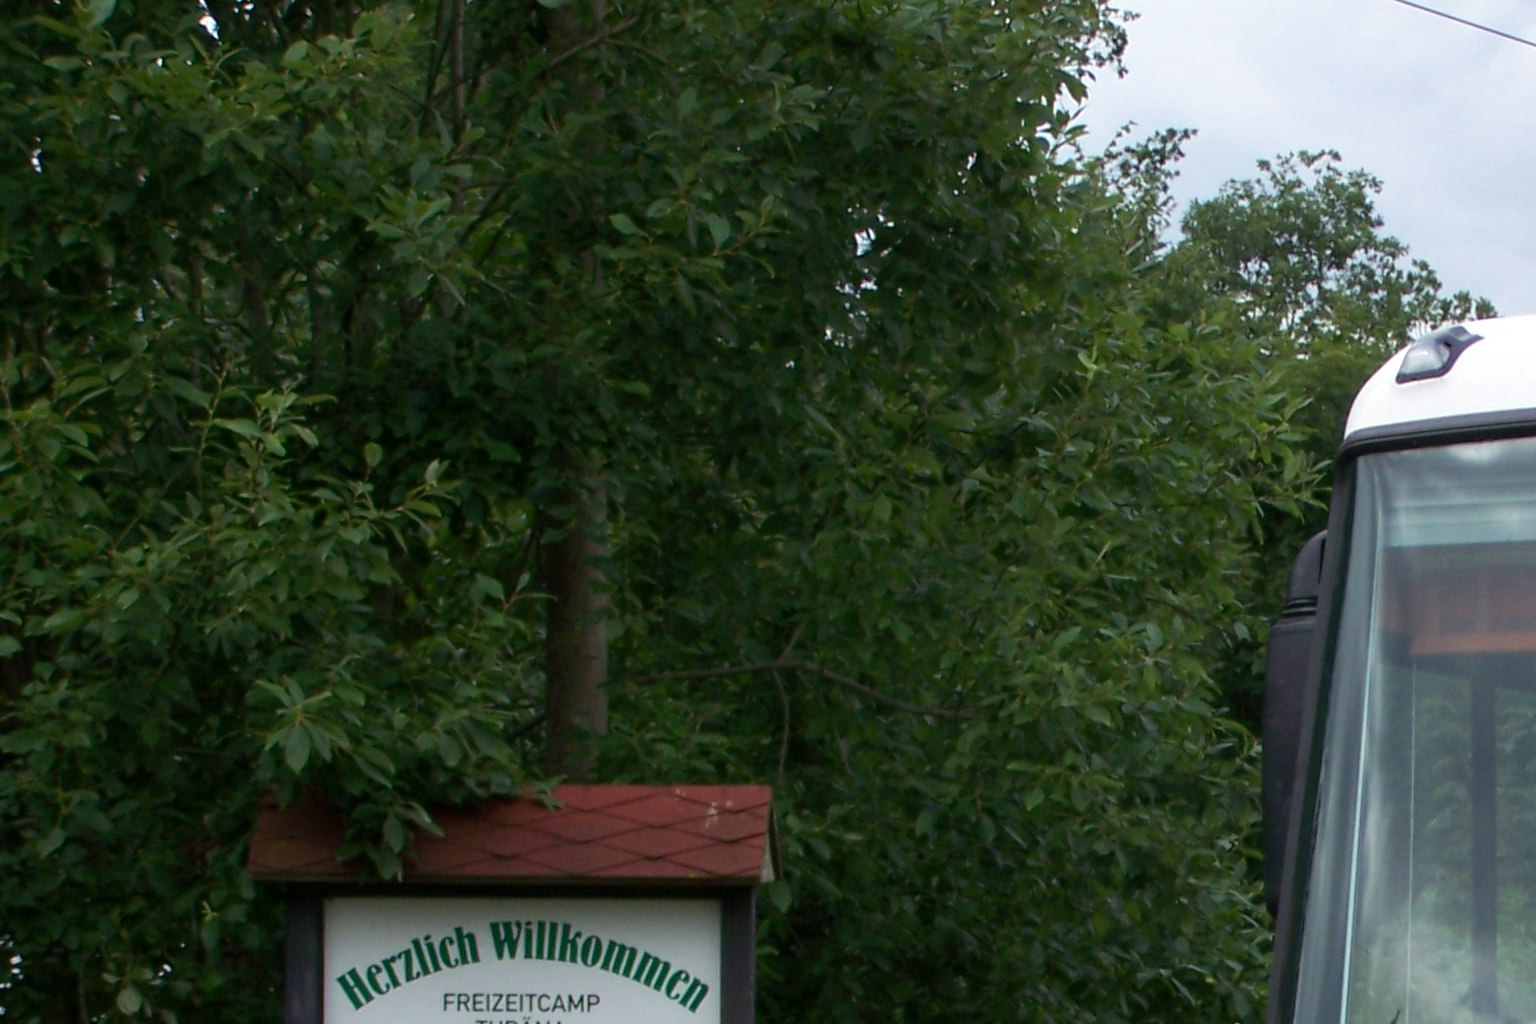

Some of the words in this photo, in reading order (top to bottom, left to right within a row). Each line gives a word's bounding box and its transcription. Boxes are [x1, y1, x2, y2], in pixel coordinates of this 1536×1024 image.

[336, 926, 480, 1012] Herzlich
[490, 919, 710, 1014] Willkommen
[443, 993, 601, 1013] FREIZEITCAMP
